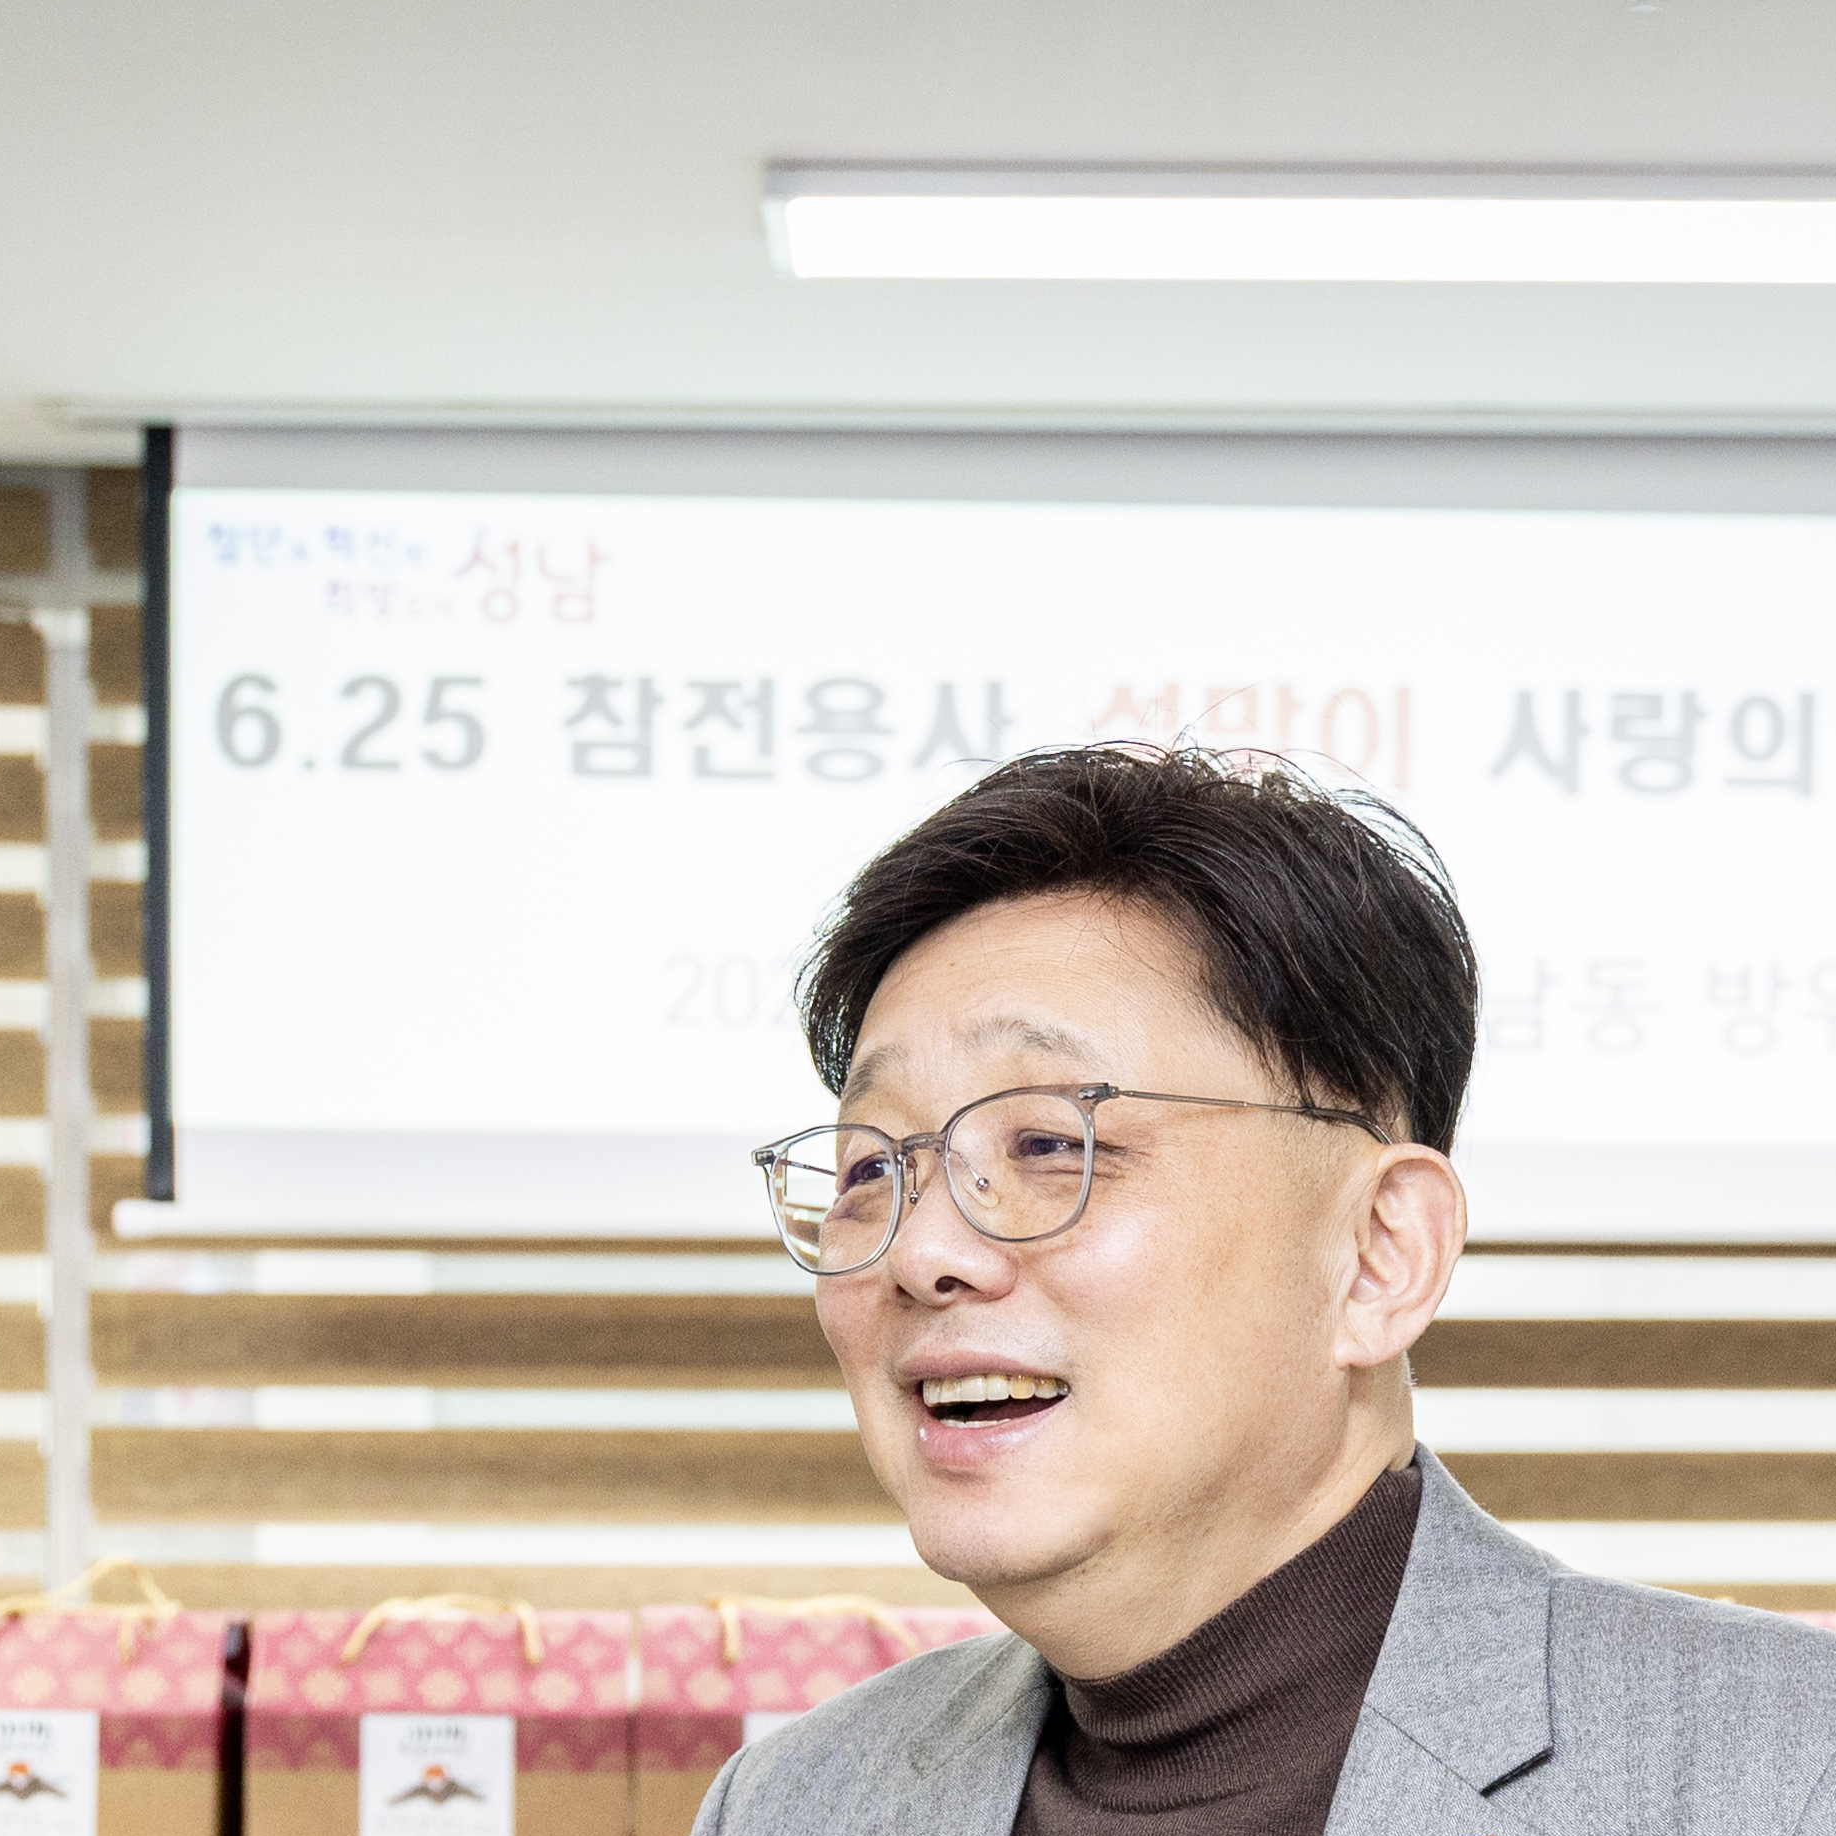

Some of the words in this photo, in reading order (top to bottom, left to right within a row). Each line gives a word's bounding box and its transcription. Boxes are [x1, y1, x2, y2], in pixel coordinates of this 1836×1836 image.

[450, 523, 615, 626] 성남
[210, 668, 489, 774] 6.25
[561, 669, 1015, 785] 참전용사
[1488, 686, 1817, 797] 사랑의
